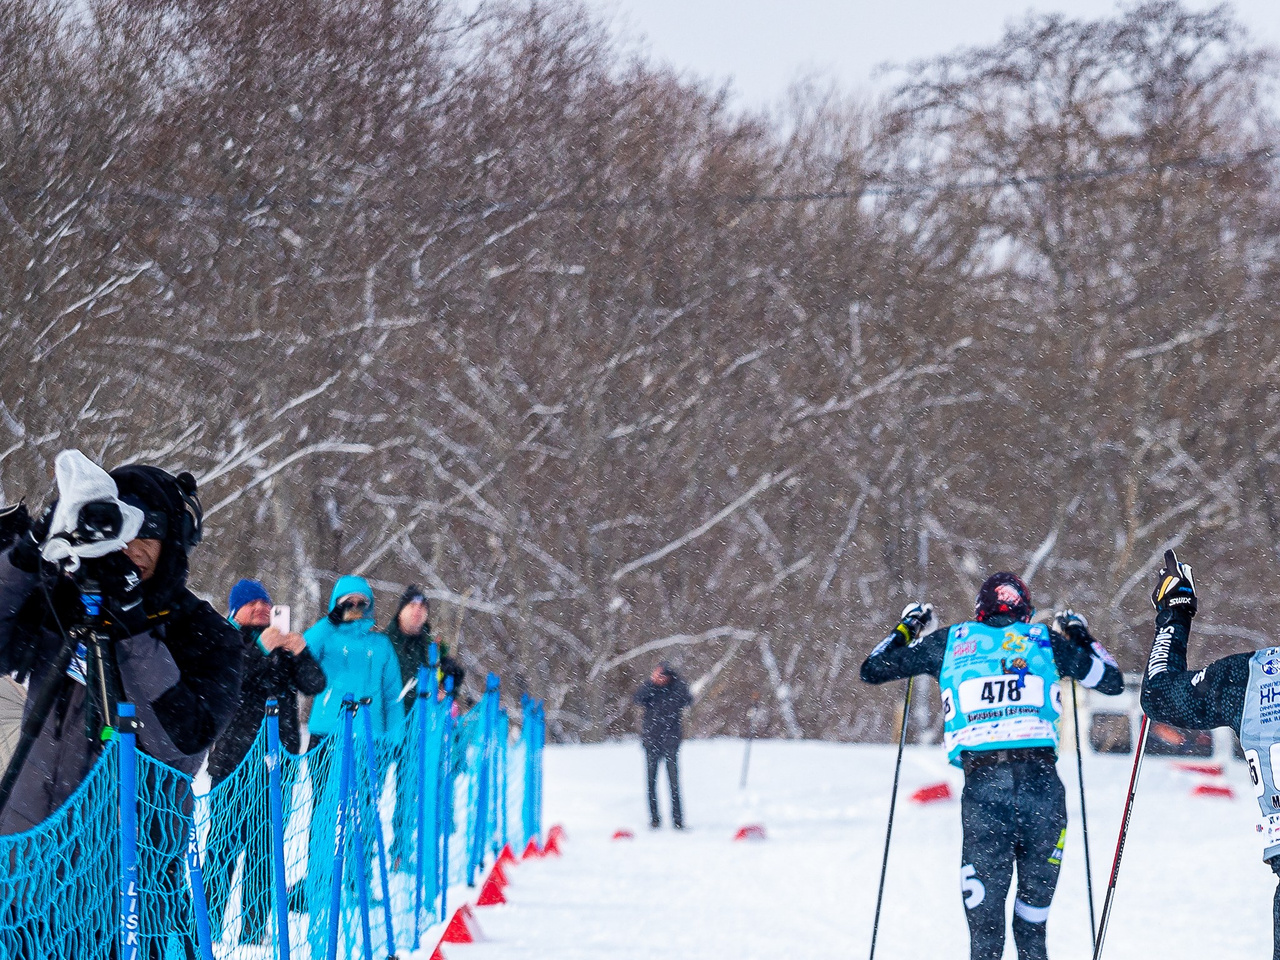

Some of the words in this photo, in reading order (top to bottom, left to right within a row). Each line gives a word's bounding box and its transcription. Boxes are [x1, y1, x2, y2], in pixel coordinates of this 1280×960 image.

[1169, 597, 1191, 607] SWIX
[1148, 625, 1175, 681] SAKHALIN
[981, 679, 1022, 704] 478
